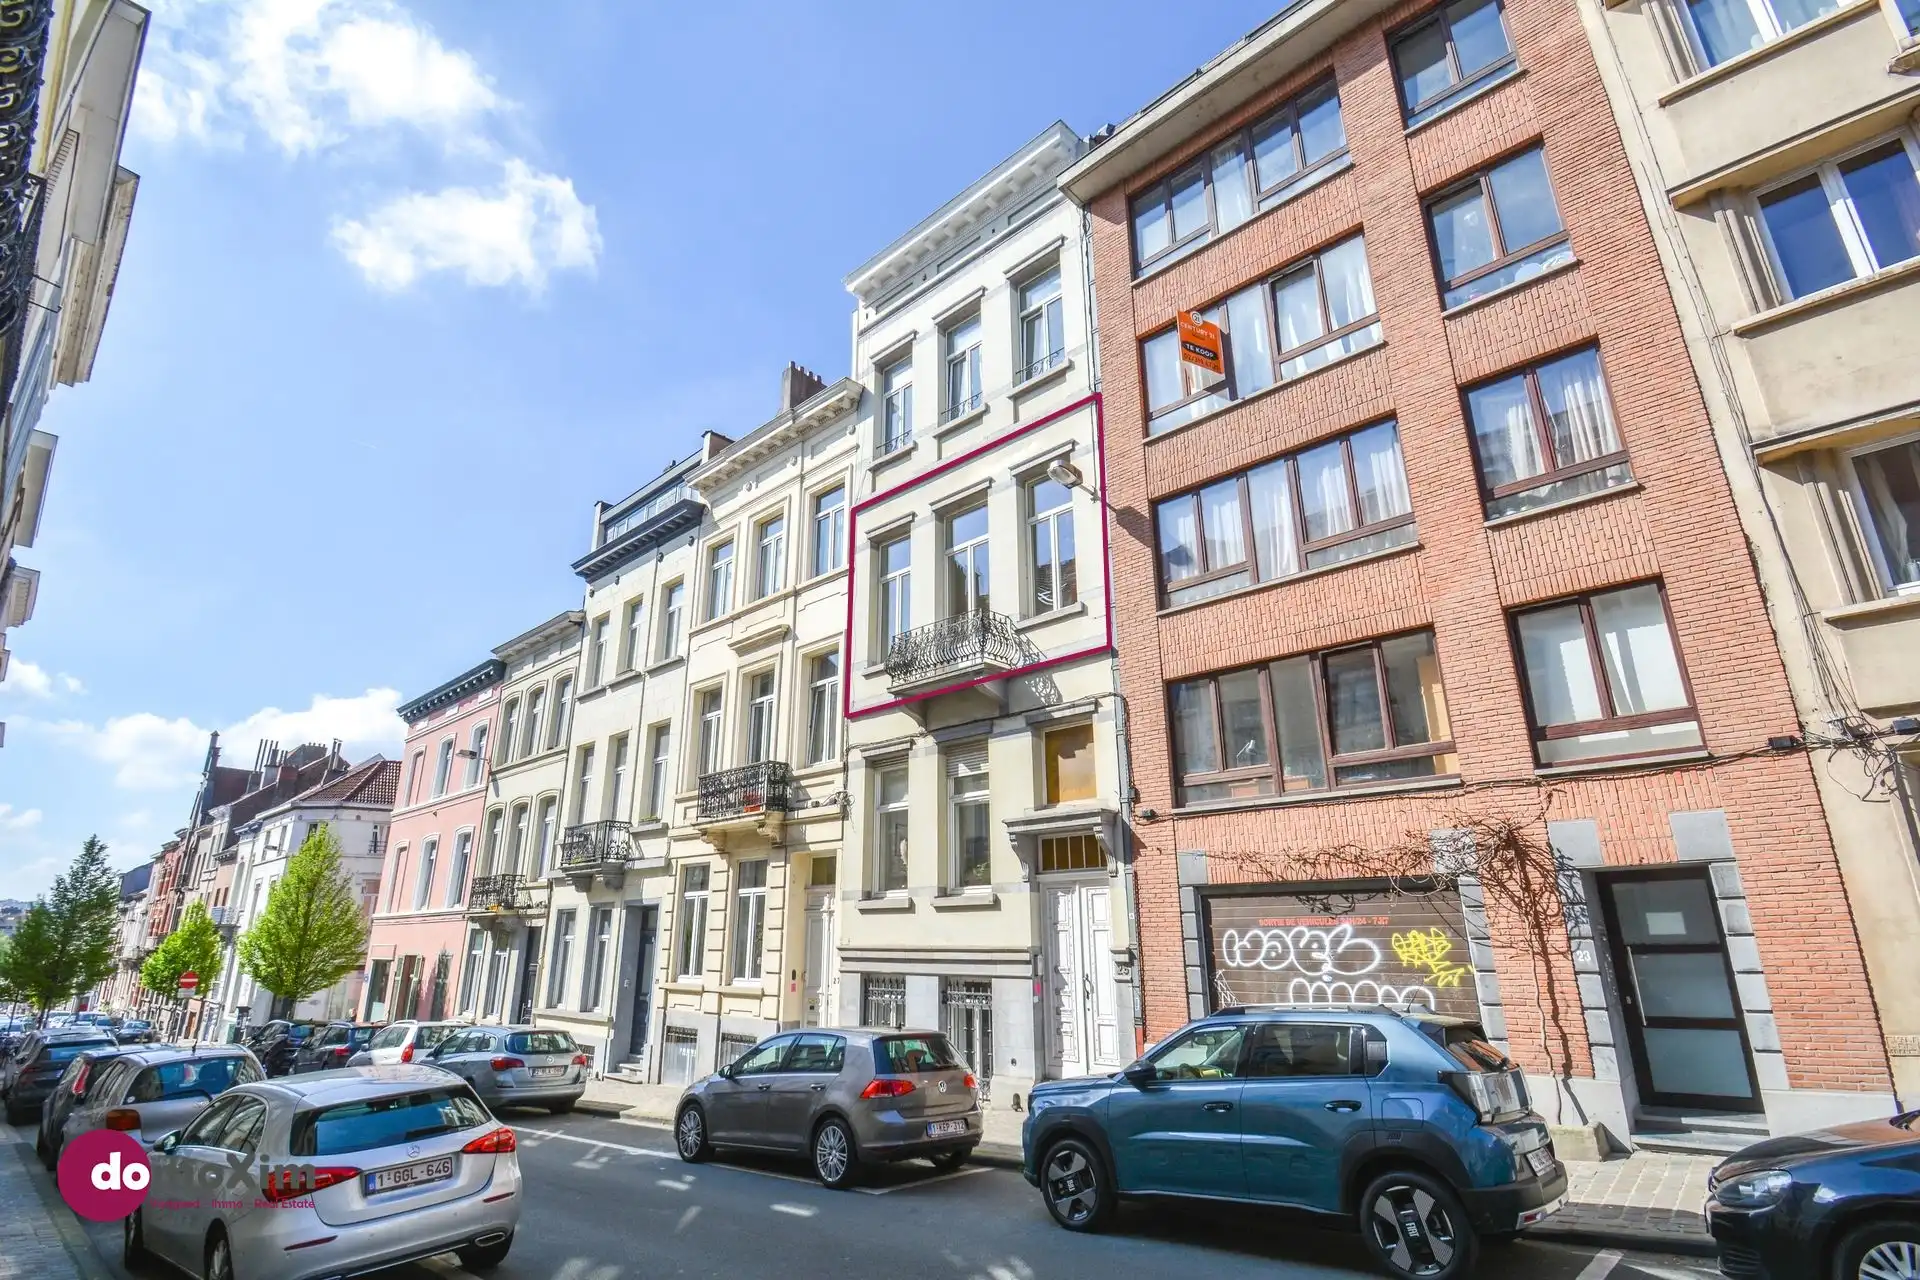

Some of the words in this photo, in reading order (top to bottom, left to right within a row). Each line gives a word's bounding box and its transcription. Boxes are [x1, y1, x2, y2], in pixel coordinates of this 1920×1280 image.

[1180, 322, 1208, 336] CENTURY
[1185, 343, 1195, 353] TE
[1195, 347, 1214, 357] KOOP
[1286, 918, 1297, 926] DE
[1577, 950, 1591, 961] 23
[377, 1160, 450, 1187] 1-GGL-646
[1405, 1222, 1420, 1237] FIAT
